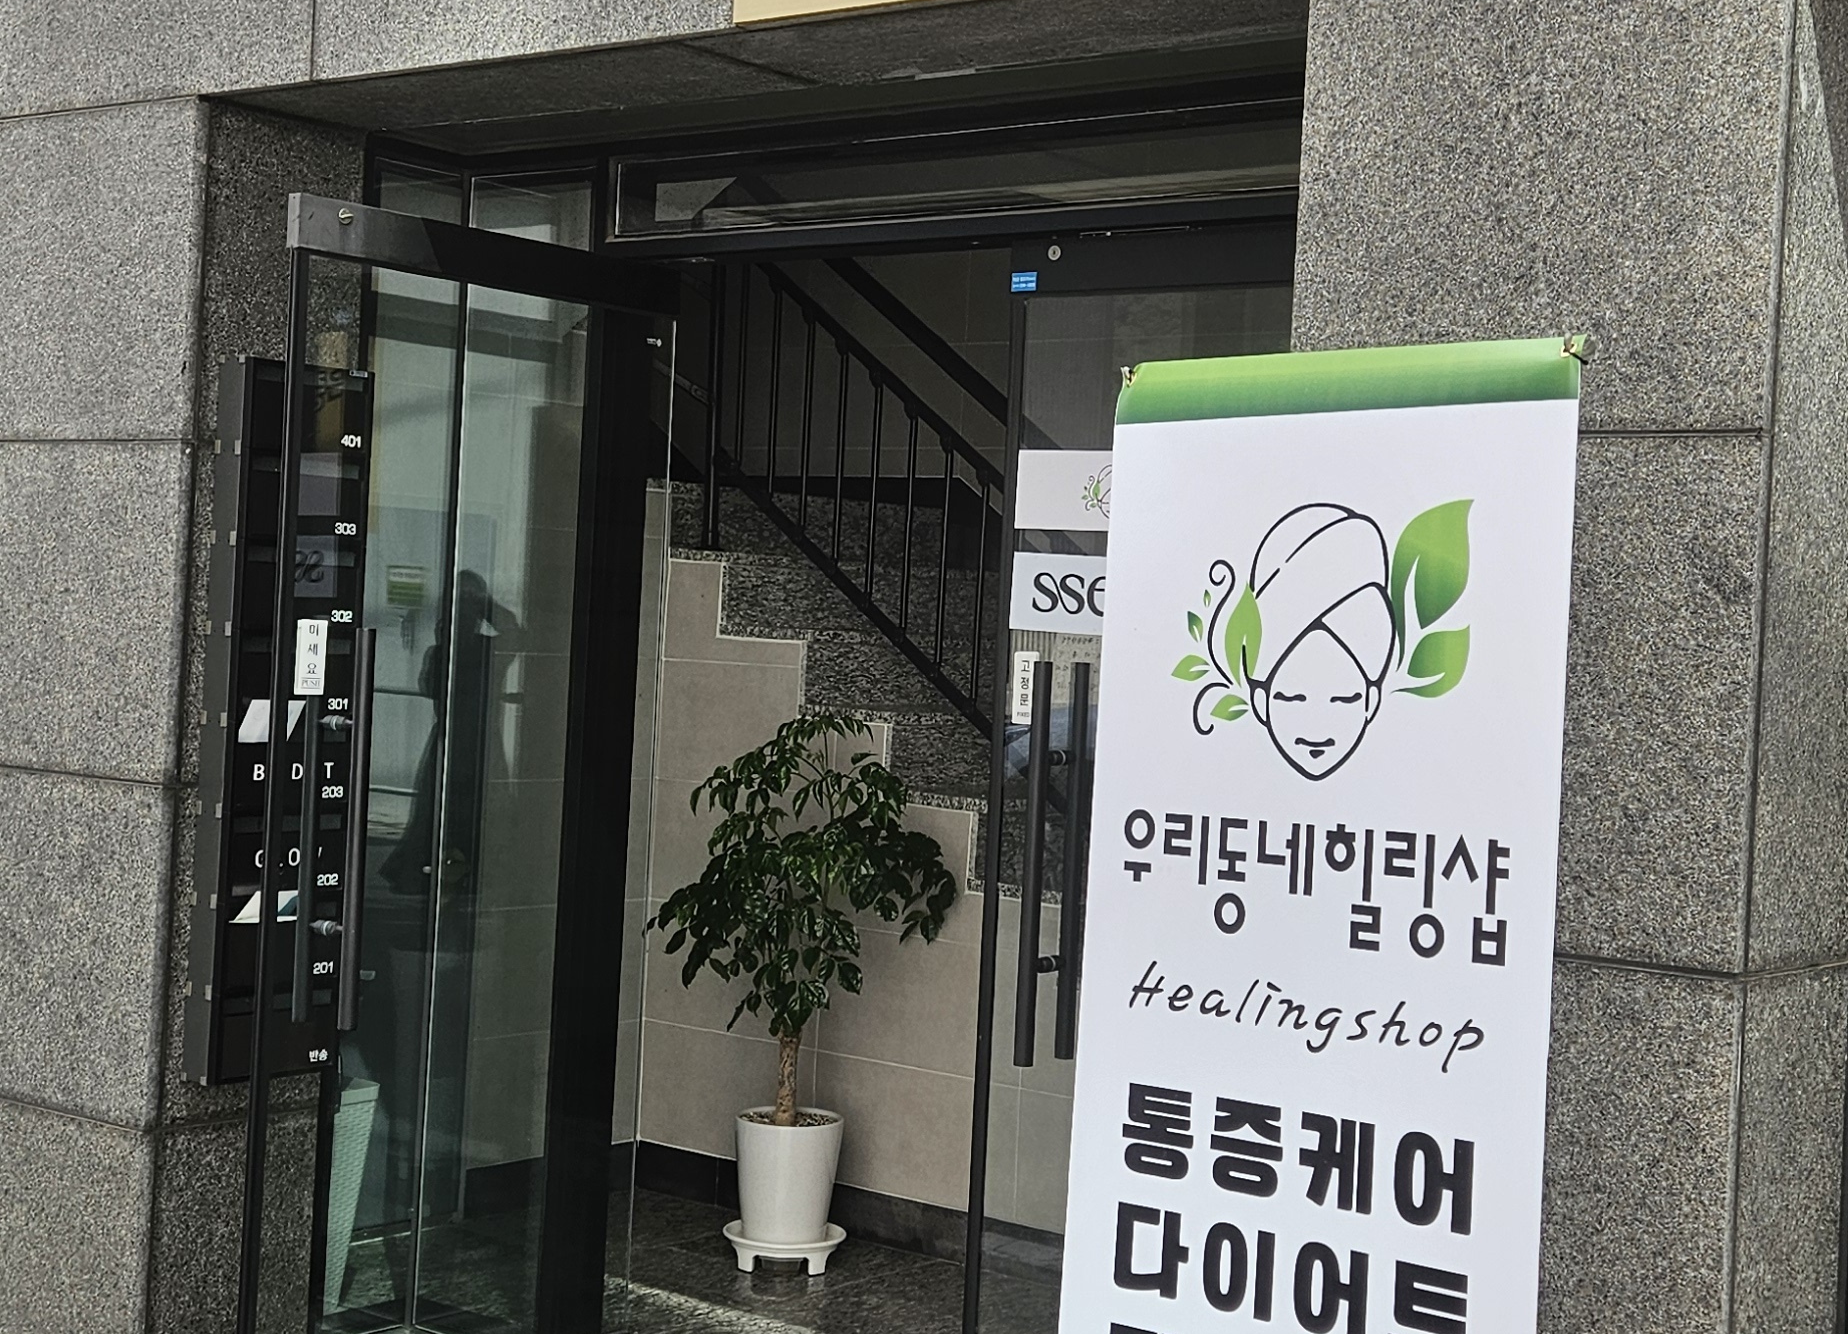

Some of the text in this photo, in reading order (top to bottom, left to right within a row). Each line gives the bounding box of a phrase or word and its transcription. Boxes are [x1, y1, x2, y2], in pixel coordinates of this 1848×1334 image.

[340, 434, 362, 449] 401
[334, 522, 357, 536] 303
[331, 609, 353, 623] 302
[327, 698, 349, 710] 301
[321, 785, 344, 799] 203
[317, 873, 339, 886] 202
[1124, 809, 1511, 967] 우리동네힐링샵
[313, 961, 334, 975] 201
[1128, 960, 1485, 1074] Healingshop
[1121, 1082, 1475, 1237] 통증케어
